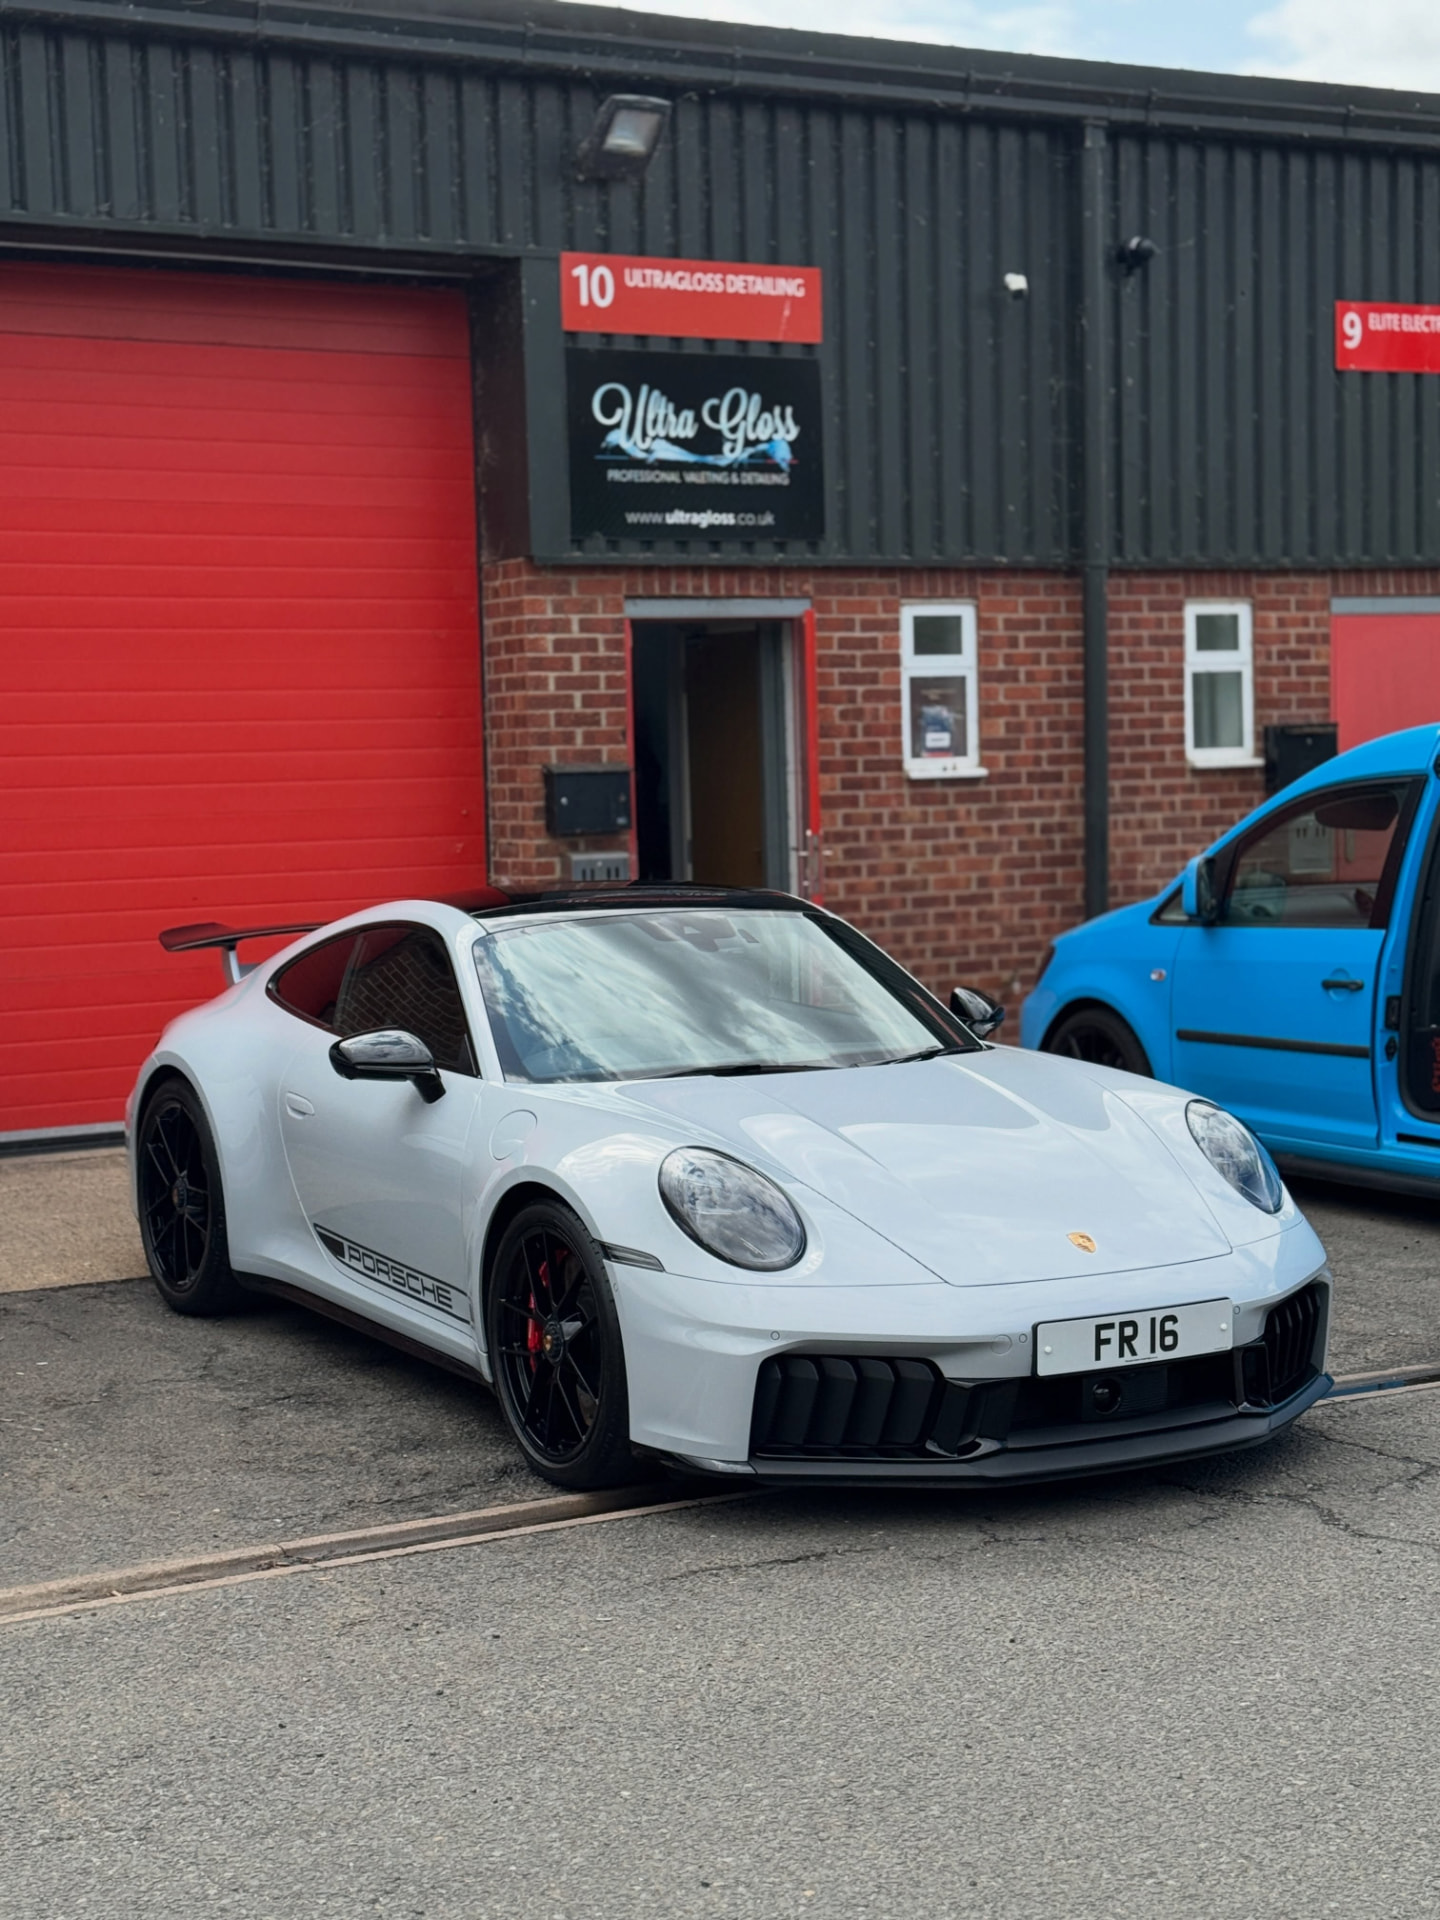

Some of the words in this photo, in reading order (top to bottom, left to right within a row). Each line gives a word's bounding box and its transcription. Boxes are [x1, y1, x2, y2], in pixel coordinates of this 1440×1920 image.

[572, 264, 614, 307] 10
[624, 268, 724, 292] ULTRAGLOSS
[726, 274, 805, 297] DETAILING
[1342, 311, 1363, 350] 9
[592, 382, 699, 450] Ultra
[701, 387, 801, 458] Gloss
[606, 469, 682, 484] PROFESSIONAL
[731, 471, 740, 485] &
[741, 472, 790, 486] DETAILING
[624, 508, 776, 529] www.ultragloss.co.uk
[348, 1246, 453, 1309] PORSCHE
[1095, 1320, 1138, 1361] FR
[1150, 1314, 1179, 1354] 16
